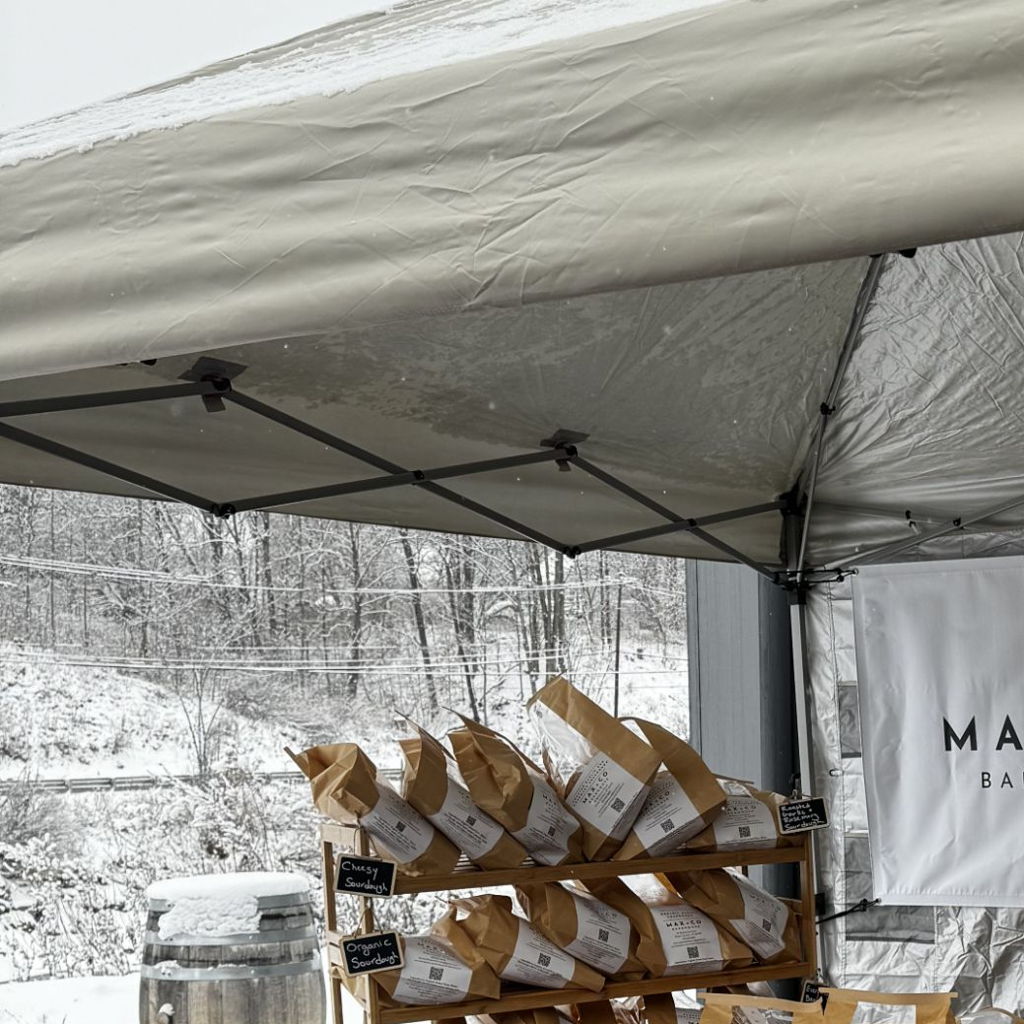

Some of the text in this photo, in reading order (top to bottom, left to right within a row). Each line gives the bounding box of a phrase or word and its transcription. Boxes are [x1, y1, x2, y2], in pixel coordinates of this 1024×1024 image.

[341, 861, 378, 880] Cheesy
[344, 877, 388, 894] Sourdough
[346, 939, 392, 956] Organic
[351, 951, 399, 969] Sourdough
